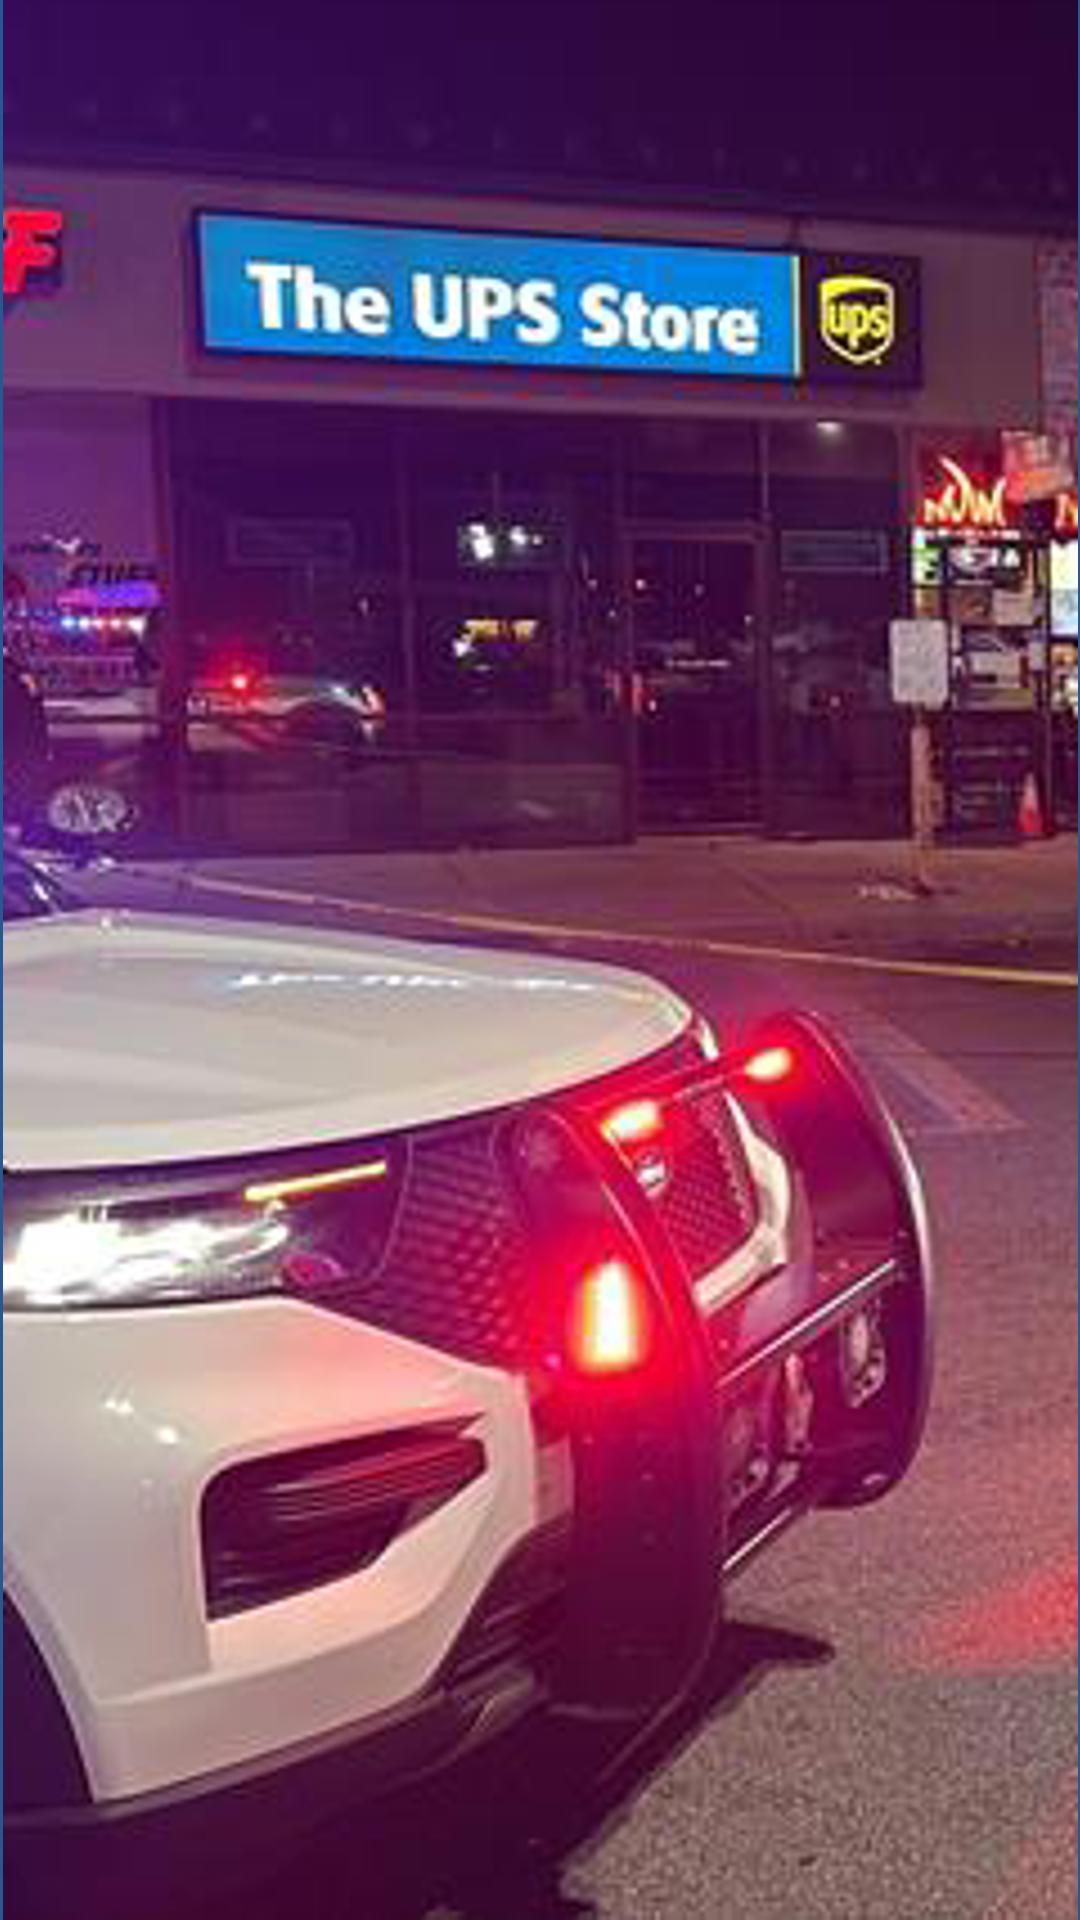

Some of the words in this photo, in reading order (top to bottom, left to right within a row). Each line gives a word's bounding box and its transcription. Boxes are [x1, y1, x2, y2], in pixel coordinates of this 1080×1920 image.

[245, 261, 391, 336] The
[411, 272, 561, 346] UPS
[579, 282, 761, 356] Store
[828, 302, 889, 350] ups
